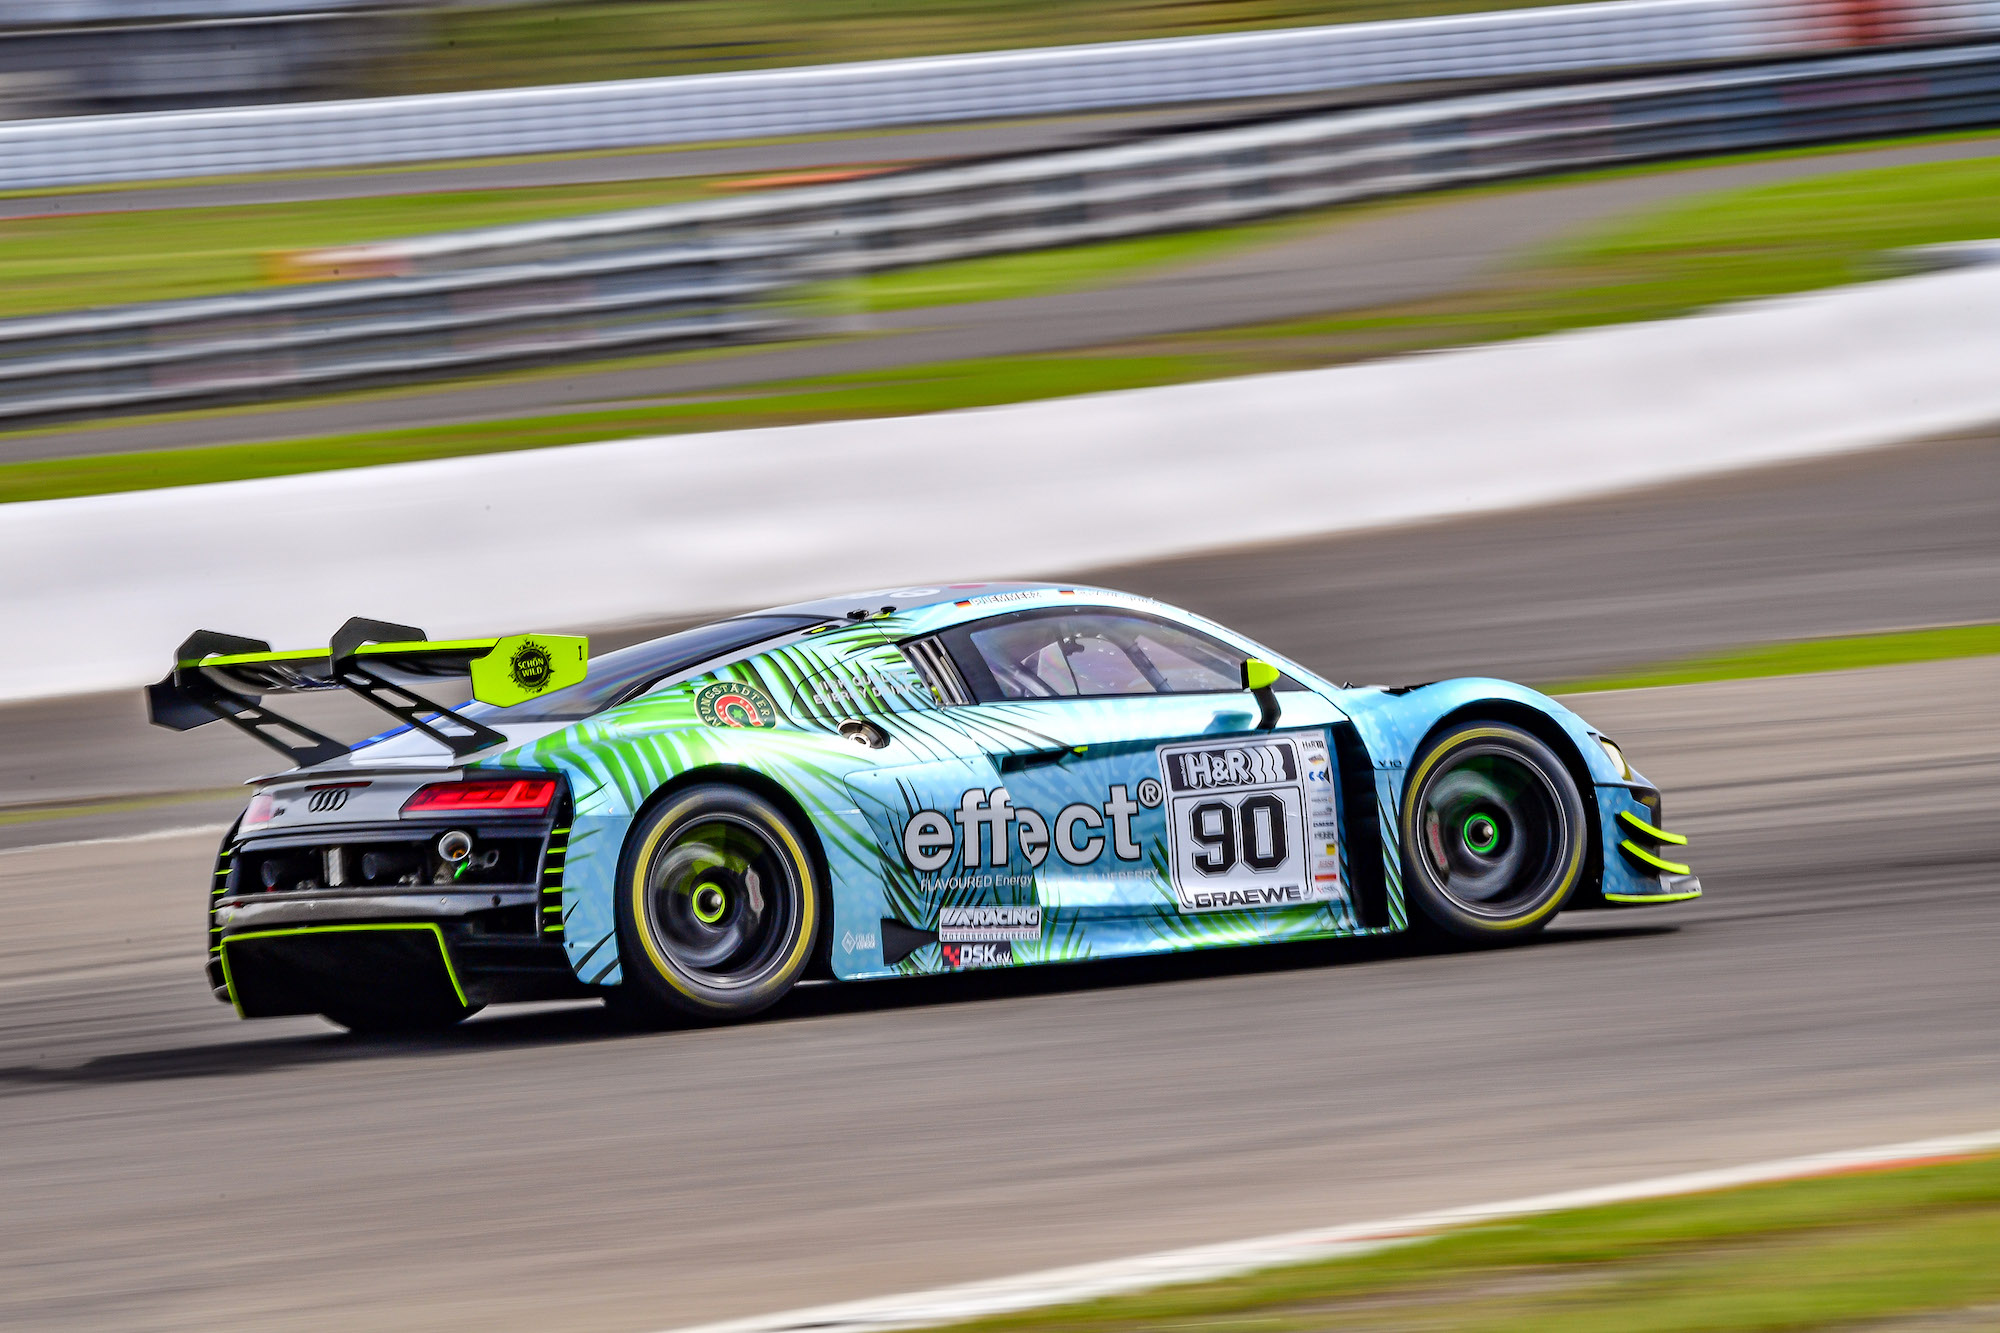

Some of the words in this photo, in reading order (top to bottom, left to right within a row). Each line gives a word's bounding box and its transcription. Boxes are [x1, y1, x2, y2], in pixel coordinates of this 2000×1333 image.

[517, 657, 544, 671] SCHÖN
[521, 666, 543, 677] WILD
[1185, 750, 1254, 790] H&R
[1189, 792, 1290, 879] 90
[920, 875, 993, 892] FLAVOURED
[995, 874, 1034, 888] Energy
[1195, 885, 1301, 908] GRAEWE
[960, 944, 997, 965] DSK
